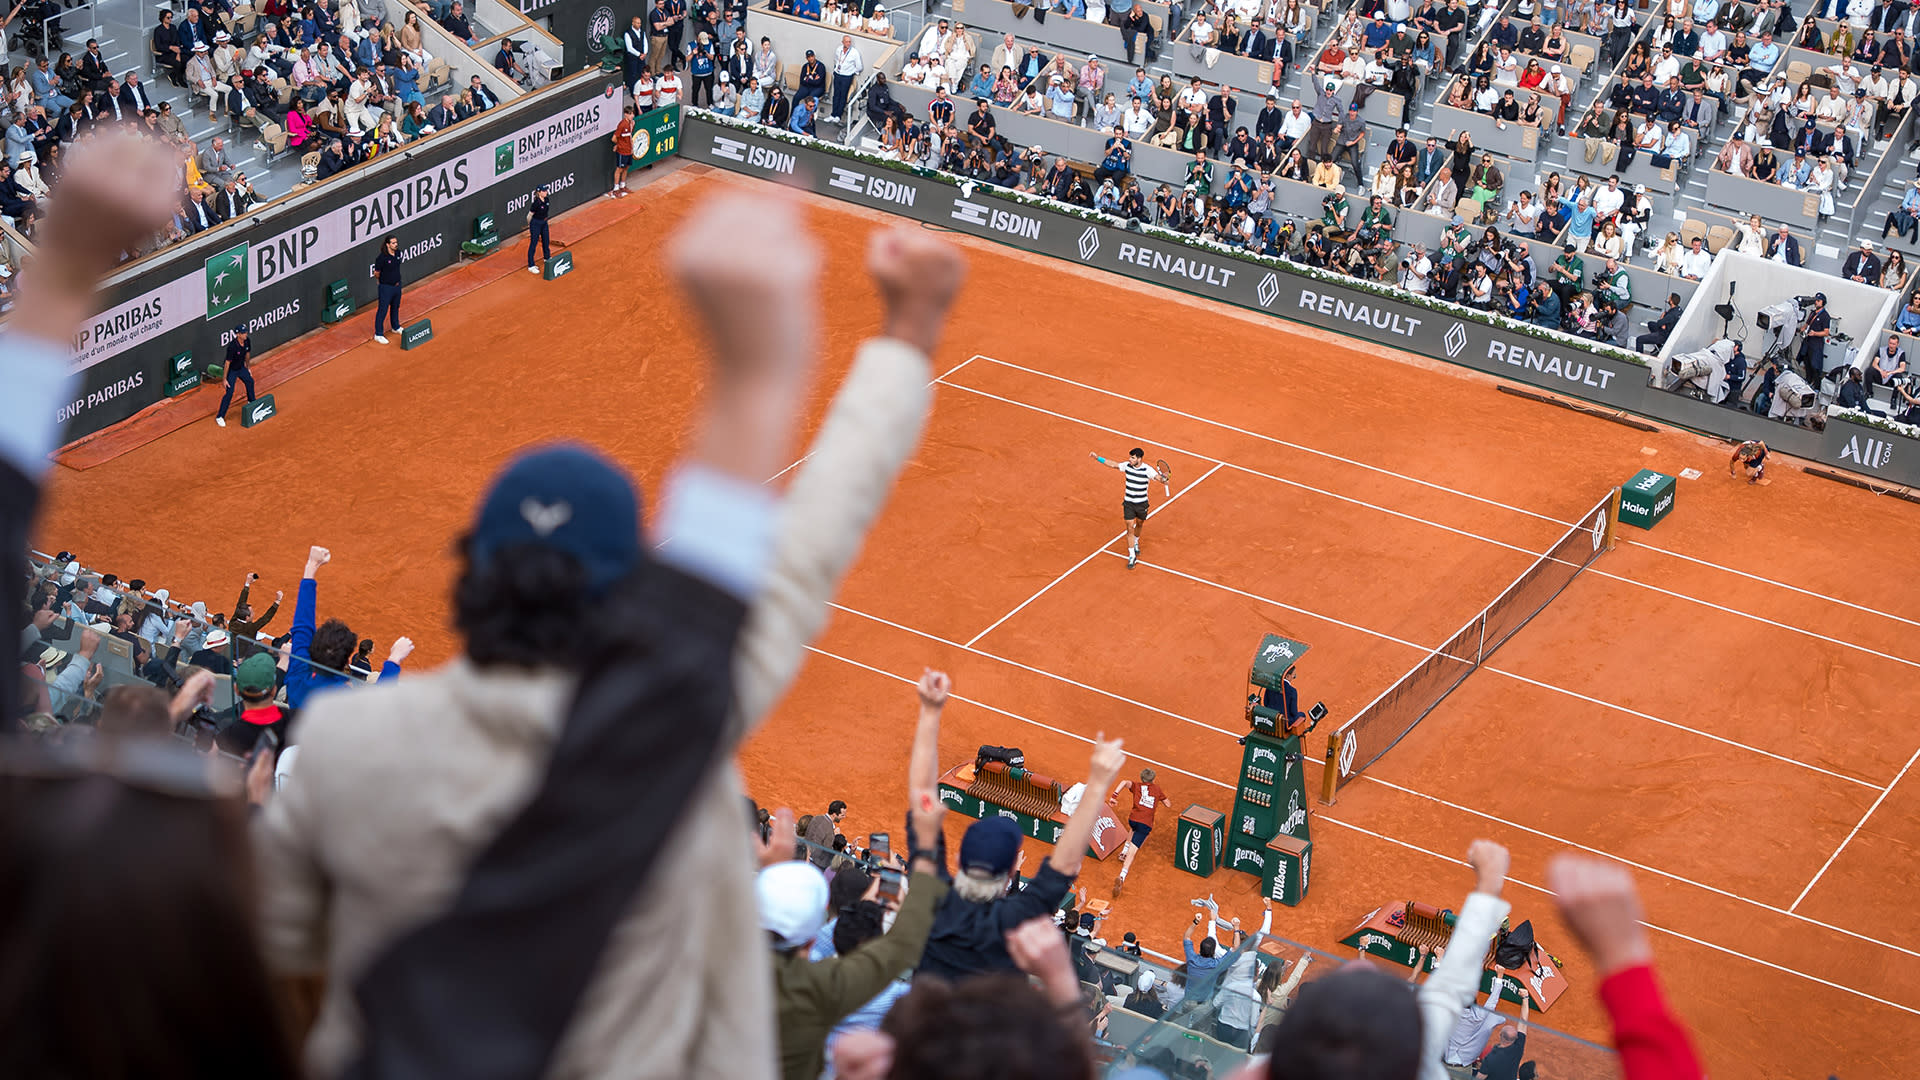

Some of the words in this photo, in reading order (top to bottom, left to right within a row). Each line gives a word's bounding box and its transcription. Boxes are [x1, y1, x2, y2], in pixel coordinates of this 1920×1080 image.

[518, 129, 545, 156] BNP
[548, 105, 600, 143] PARIBAS
[656, 121, 676, 134] ROLEX
[656, 136, 674, 155] 4:10
[747, 145, 797, 175] ISDIN
[507, 193, 529, 214] BNP
[531, 172, 575, 203] PRIBAS
[866, 176, 917, 207] ISDIN
[257, 226, 319, 285] BNP
[350, 158, 469, 243] PARIBAS
[989, 208, 1042, 241] ISDIN
[400, 233, 442, 263] ARIBAS
[481, 235, 498, 247] ACOSTE
[1118, 242, 1236, 288] RENAULT
[69, 329, 90, 354] NP
[94, 297, 162, 344] PARIBAS
[220, 328, 239, 347] BN
[249, 298, 300, 334] PARIBAS
[1298, 289, 1422, 337] RENAULT
[91, 344, 106, 357] d'un
[106, 334, 128, 350] monde
[129, 328, 140, 341] qui
[140, 319, 163, 336] change
[408, 327, 430, 343] LACOSTE
[1487, 339, 1616, 390] RENAULT
[56, 399, 84, 424] BNP
[87, 371, 144, 409] PARIBAS
[174, 375, 198, 391] LACOSTE
[1635, 472, 1664, 491] Haier
[1622, 500, 1650, 516] Haier
[1653, 492, 1673, 517] Haier
[1233, 847, 1265, 868] Perrier
[1272, 860, 1287, 900] Wilson
[1490, 976, 1519, 995] Prrier
